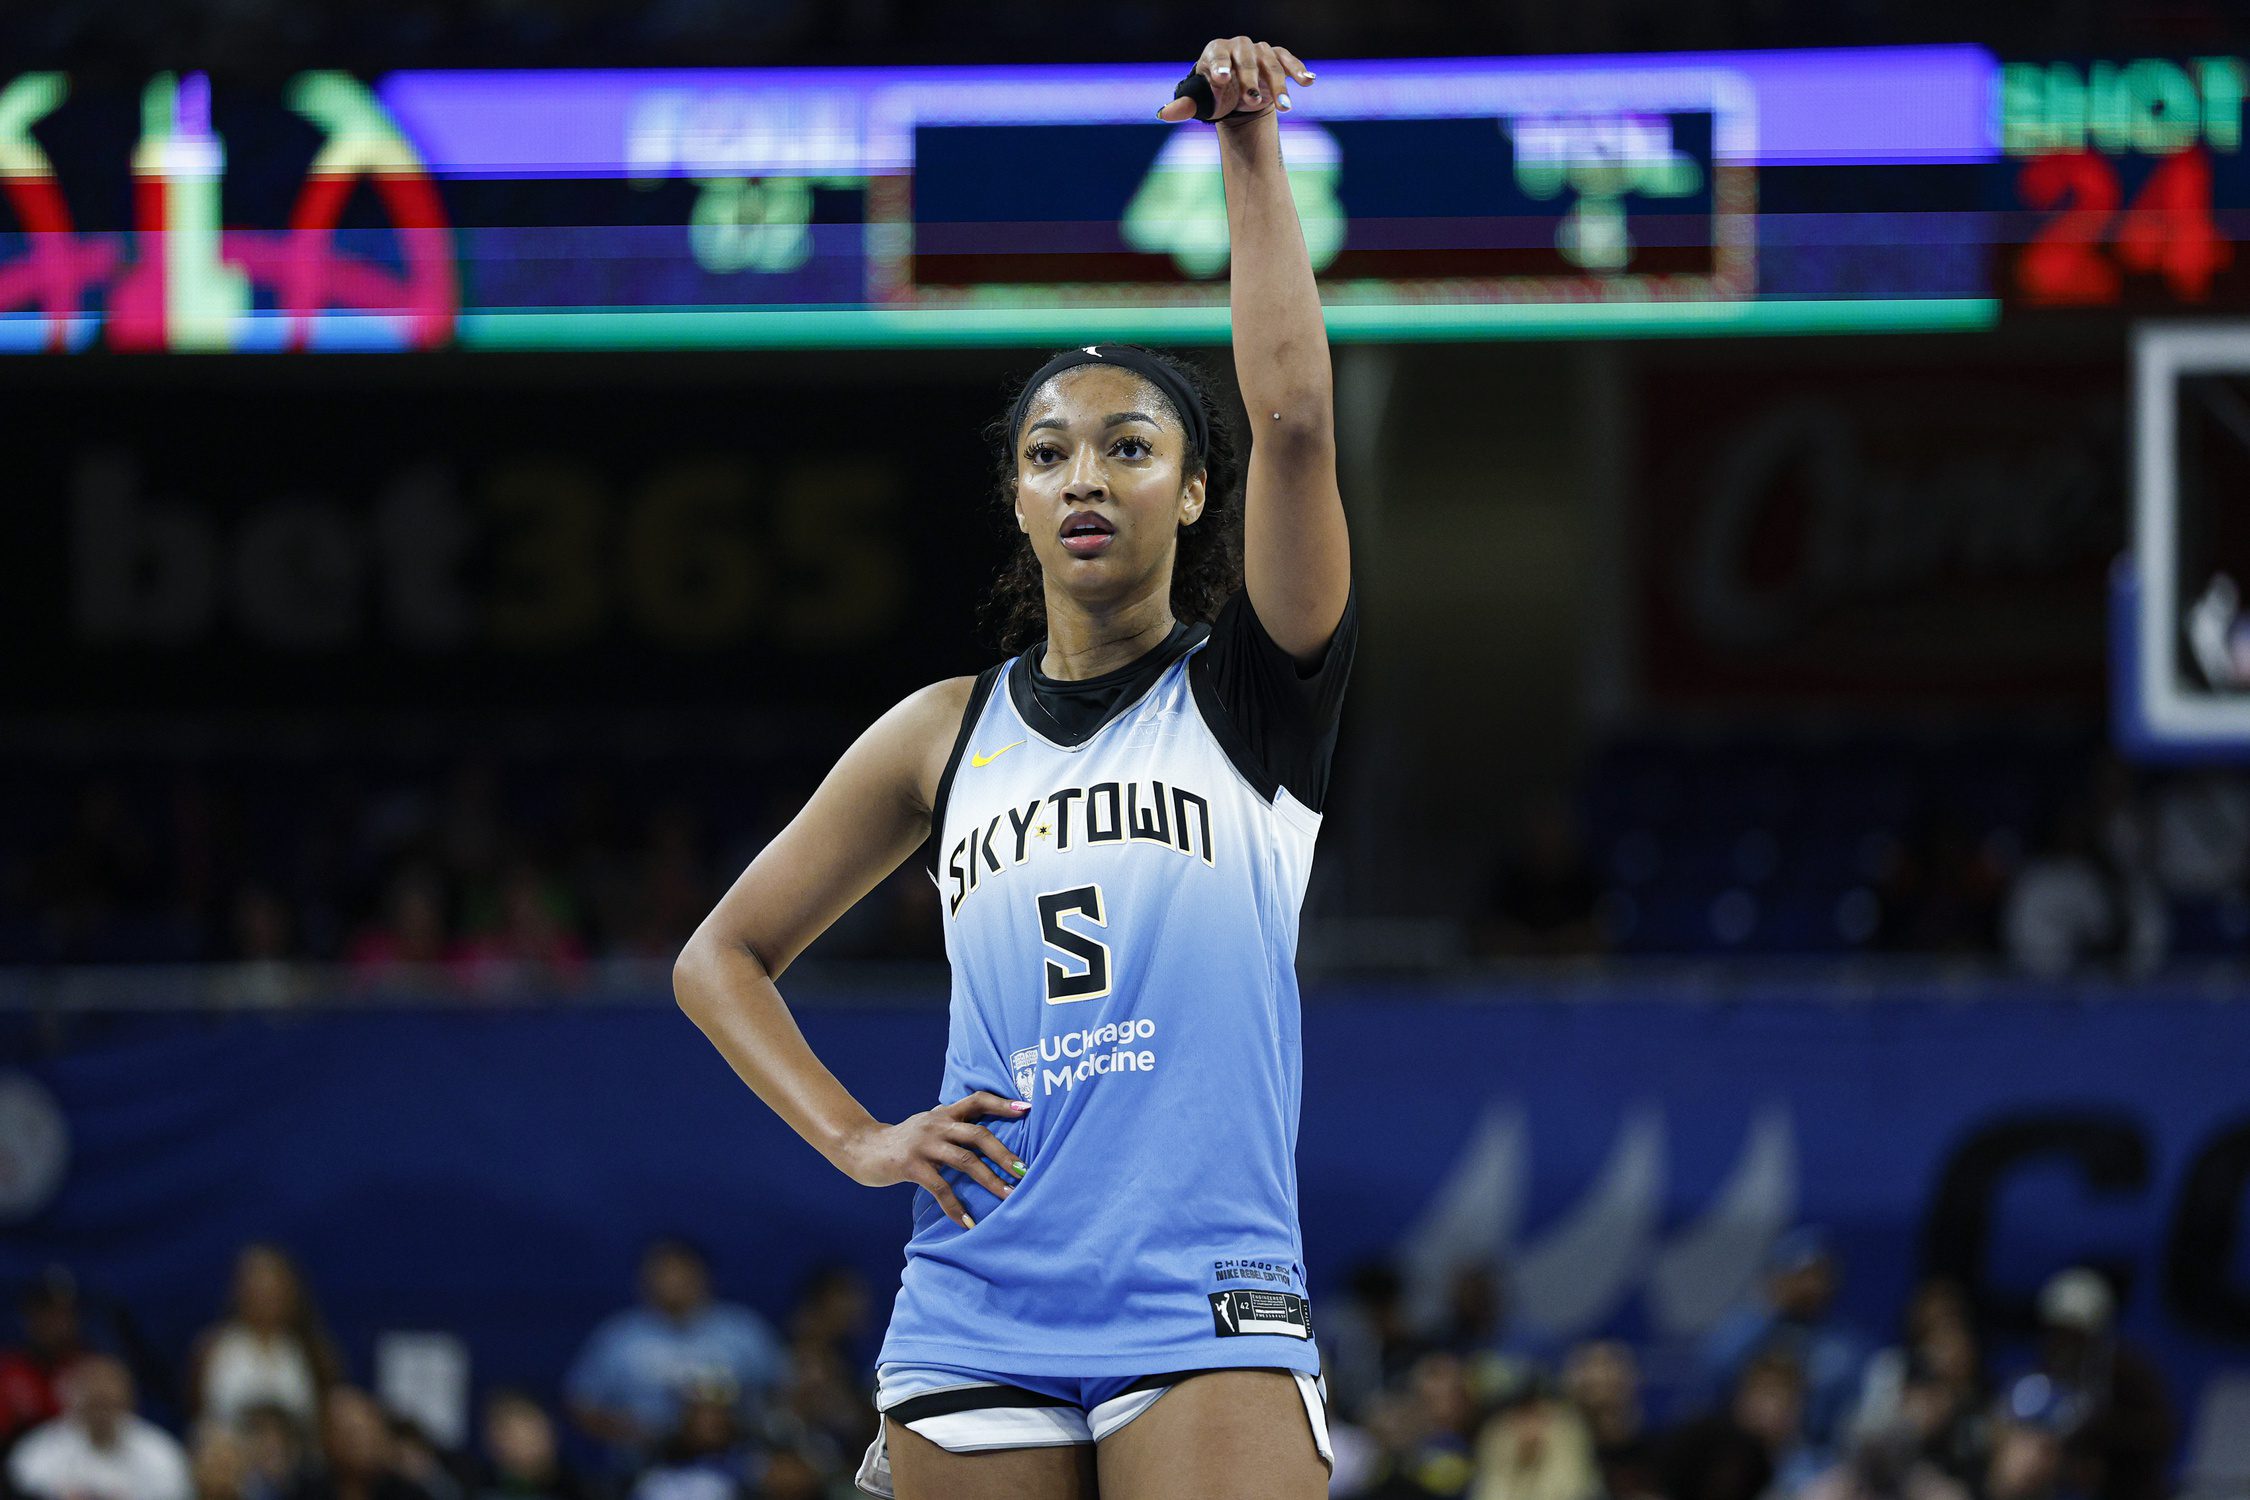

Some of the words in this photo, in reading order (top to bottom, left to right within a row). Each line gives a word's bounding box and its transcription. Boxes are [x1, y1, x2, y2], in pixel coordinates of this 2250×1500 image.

[2017, 150, 2235, 304] 24
[66, 447, 910, 651] bet365
[1036, 882, 1111, 1004] 5
[1039, 1018, 1156, 1062] UChcago
[1042, 1046, 1156, 1096] Mdcine
[1214, 1260, 1272, 1271] CHICAGO
[1215, 1269, 1239, 1282] NIKE
[1240, 1301, 1250, 1310] 42
